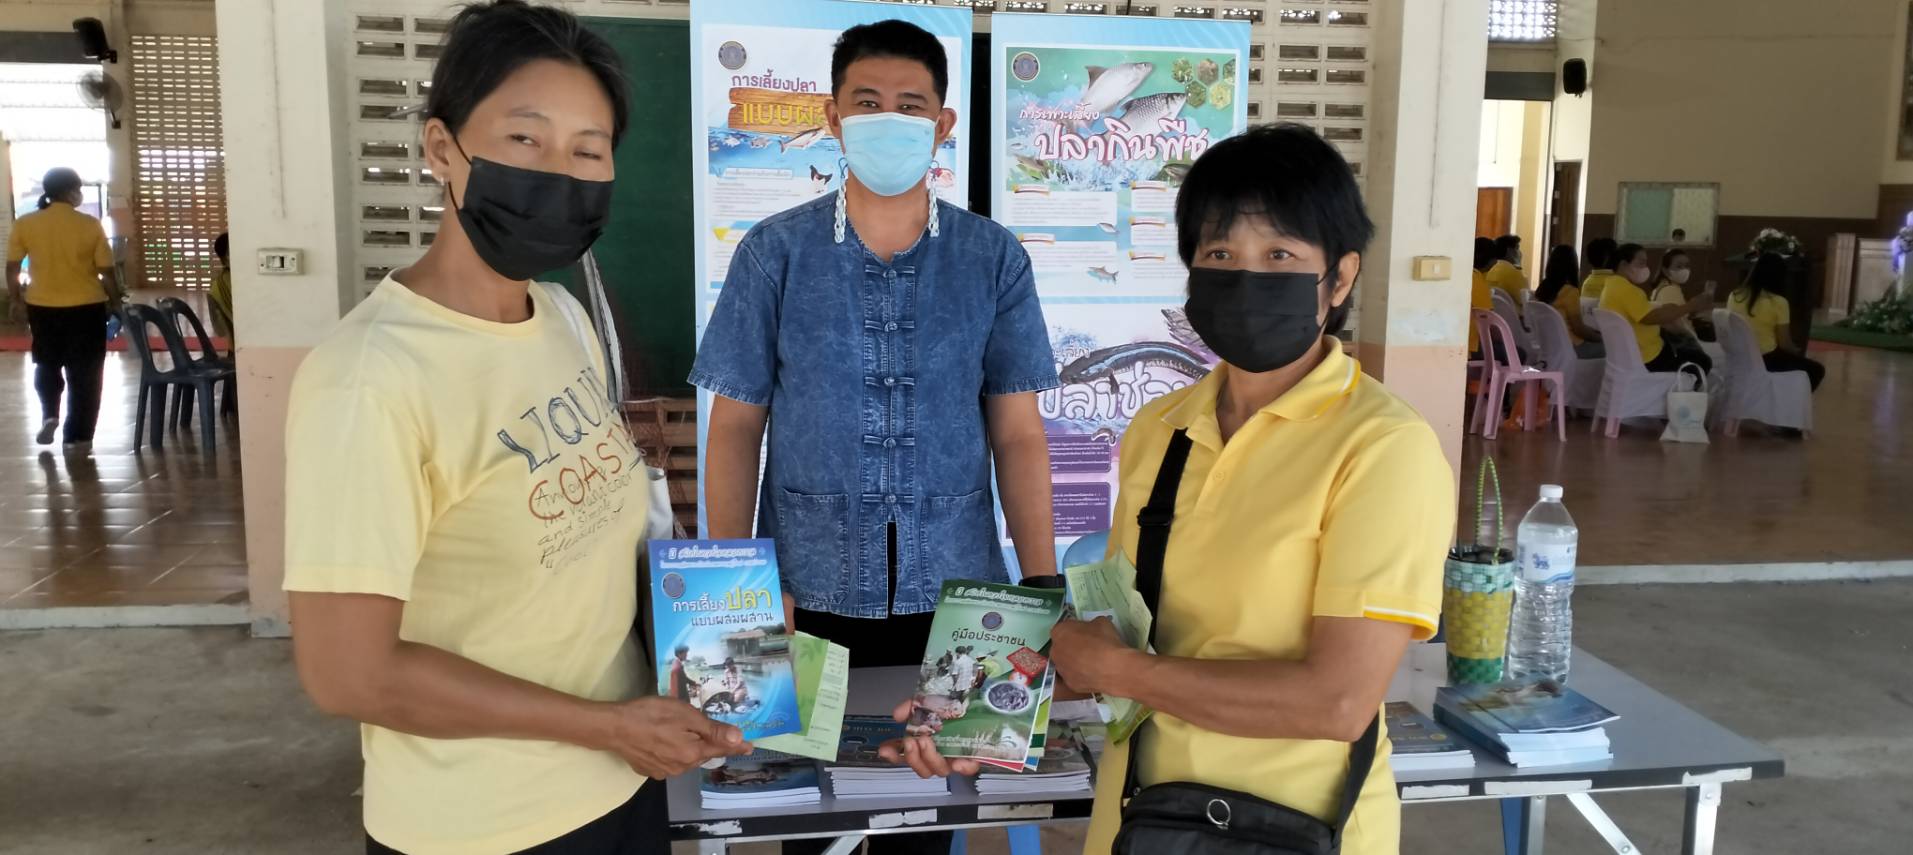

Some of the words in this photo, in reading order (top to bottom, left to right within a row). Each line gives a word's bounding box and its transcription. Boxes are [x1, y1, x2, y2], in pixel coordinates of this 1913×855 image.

[732, 68, 817, 92] การเลี้ยงปลา
[1034, 116, 1209, 161] ปลากินพืช
[672, 586, 773, 613] การเลี้ยงปลา
[691, 611, 774, 627] แบบผสมผสาน
[951, 627, 1027, 647] คู่มือประชาชน
